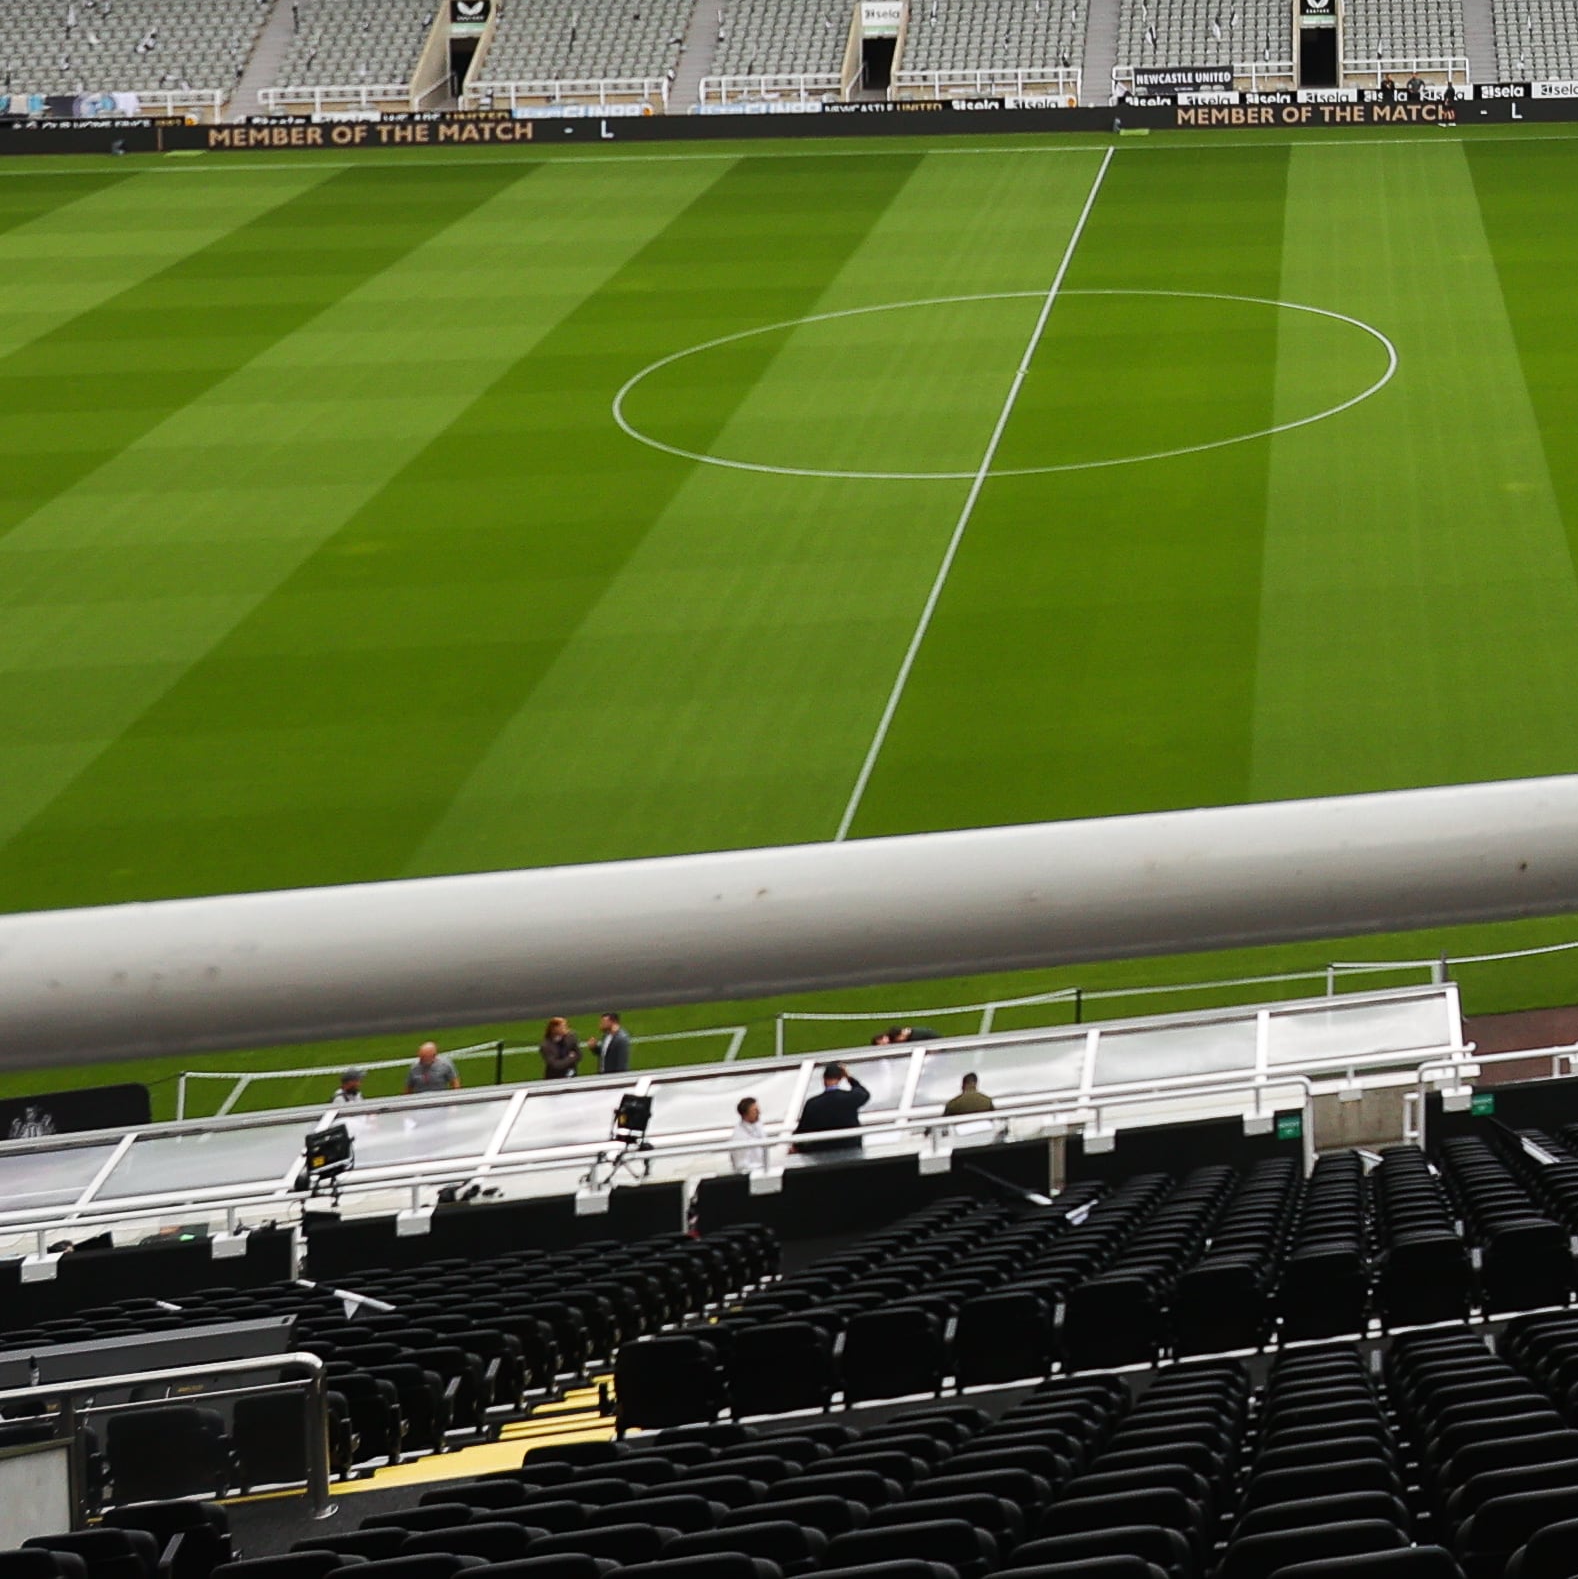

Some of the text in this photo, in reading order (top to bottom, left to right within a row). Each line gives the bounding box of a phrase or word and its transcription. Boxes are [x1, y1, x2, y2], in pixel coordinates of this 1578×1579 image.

[1136, 71, 1231, 85] NEWCASTLE UNITED
[1177, 106, 1274, 125] MEMBER
[1282, 106, 1312, 123] OF
[1320, 105, 1365, 122] THE
[208, 126, 323, 147] MEMBER
[331, 125, 368, 144] OF
[377, 124, 430, 143] THE
[438, 121, 533, 142] MATCH
